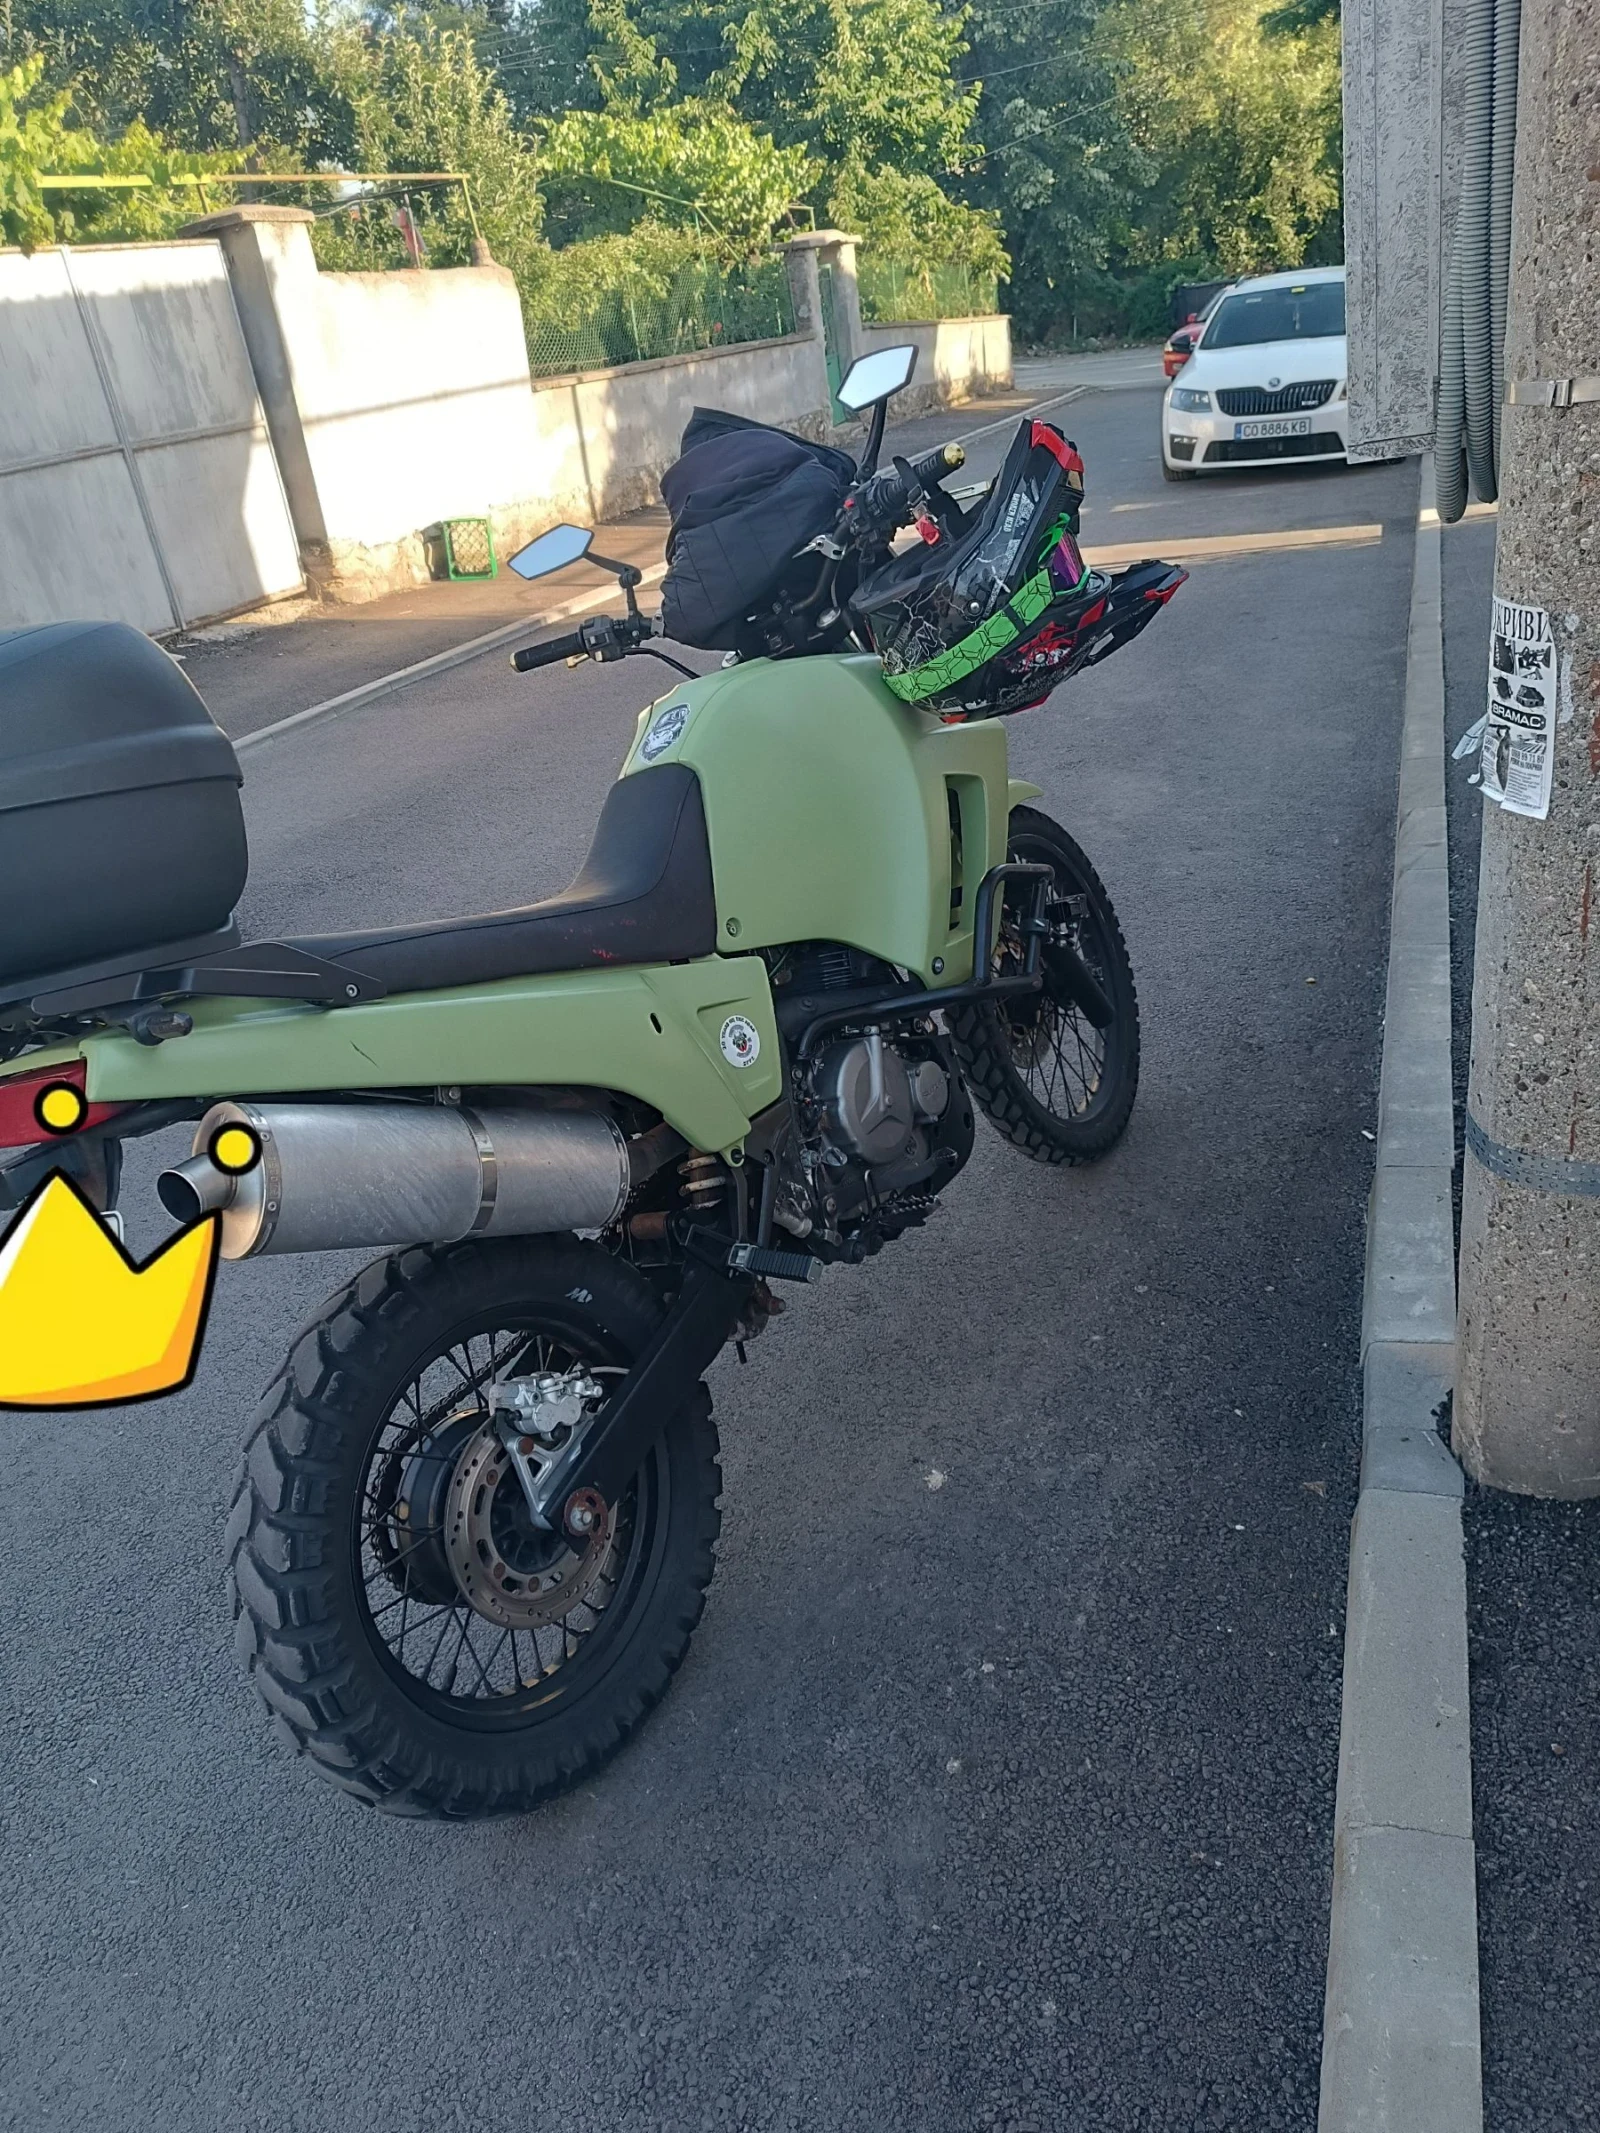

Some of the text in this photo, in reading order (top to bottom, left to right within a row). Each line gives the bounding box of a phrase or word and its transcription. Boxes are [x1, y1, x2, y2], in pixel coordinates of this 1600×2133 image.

[1261, 423, 1289, 436] 8886
[1291, 421, 1307, 433] KB
[1492, 703, 1541, 728] BRAMAC
